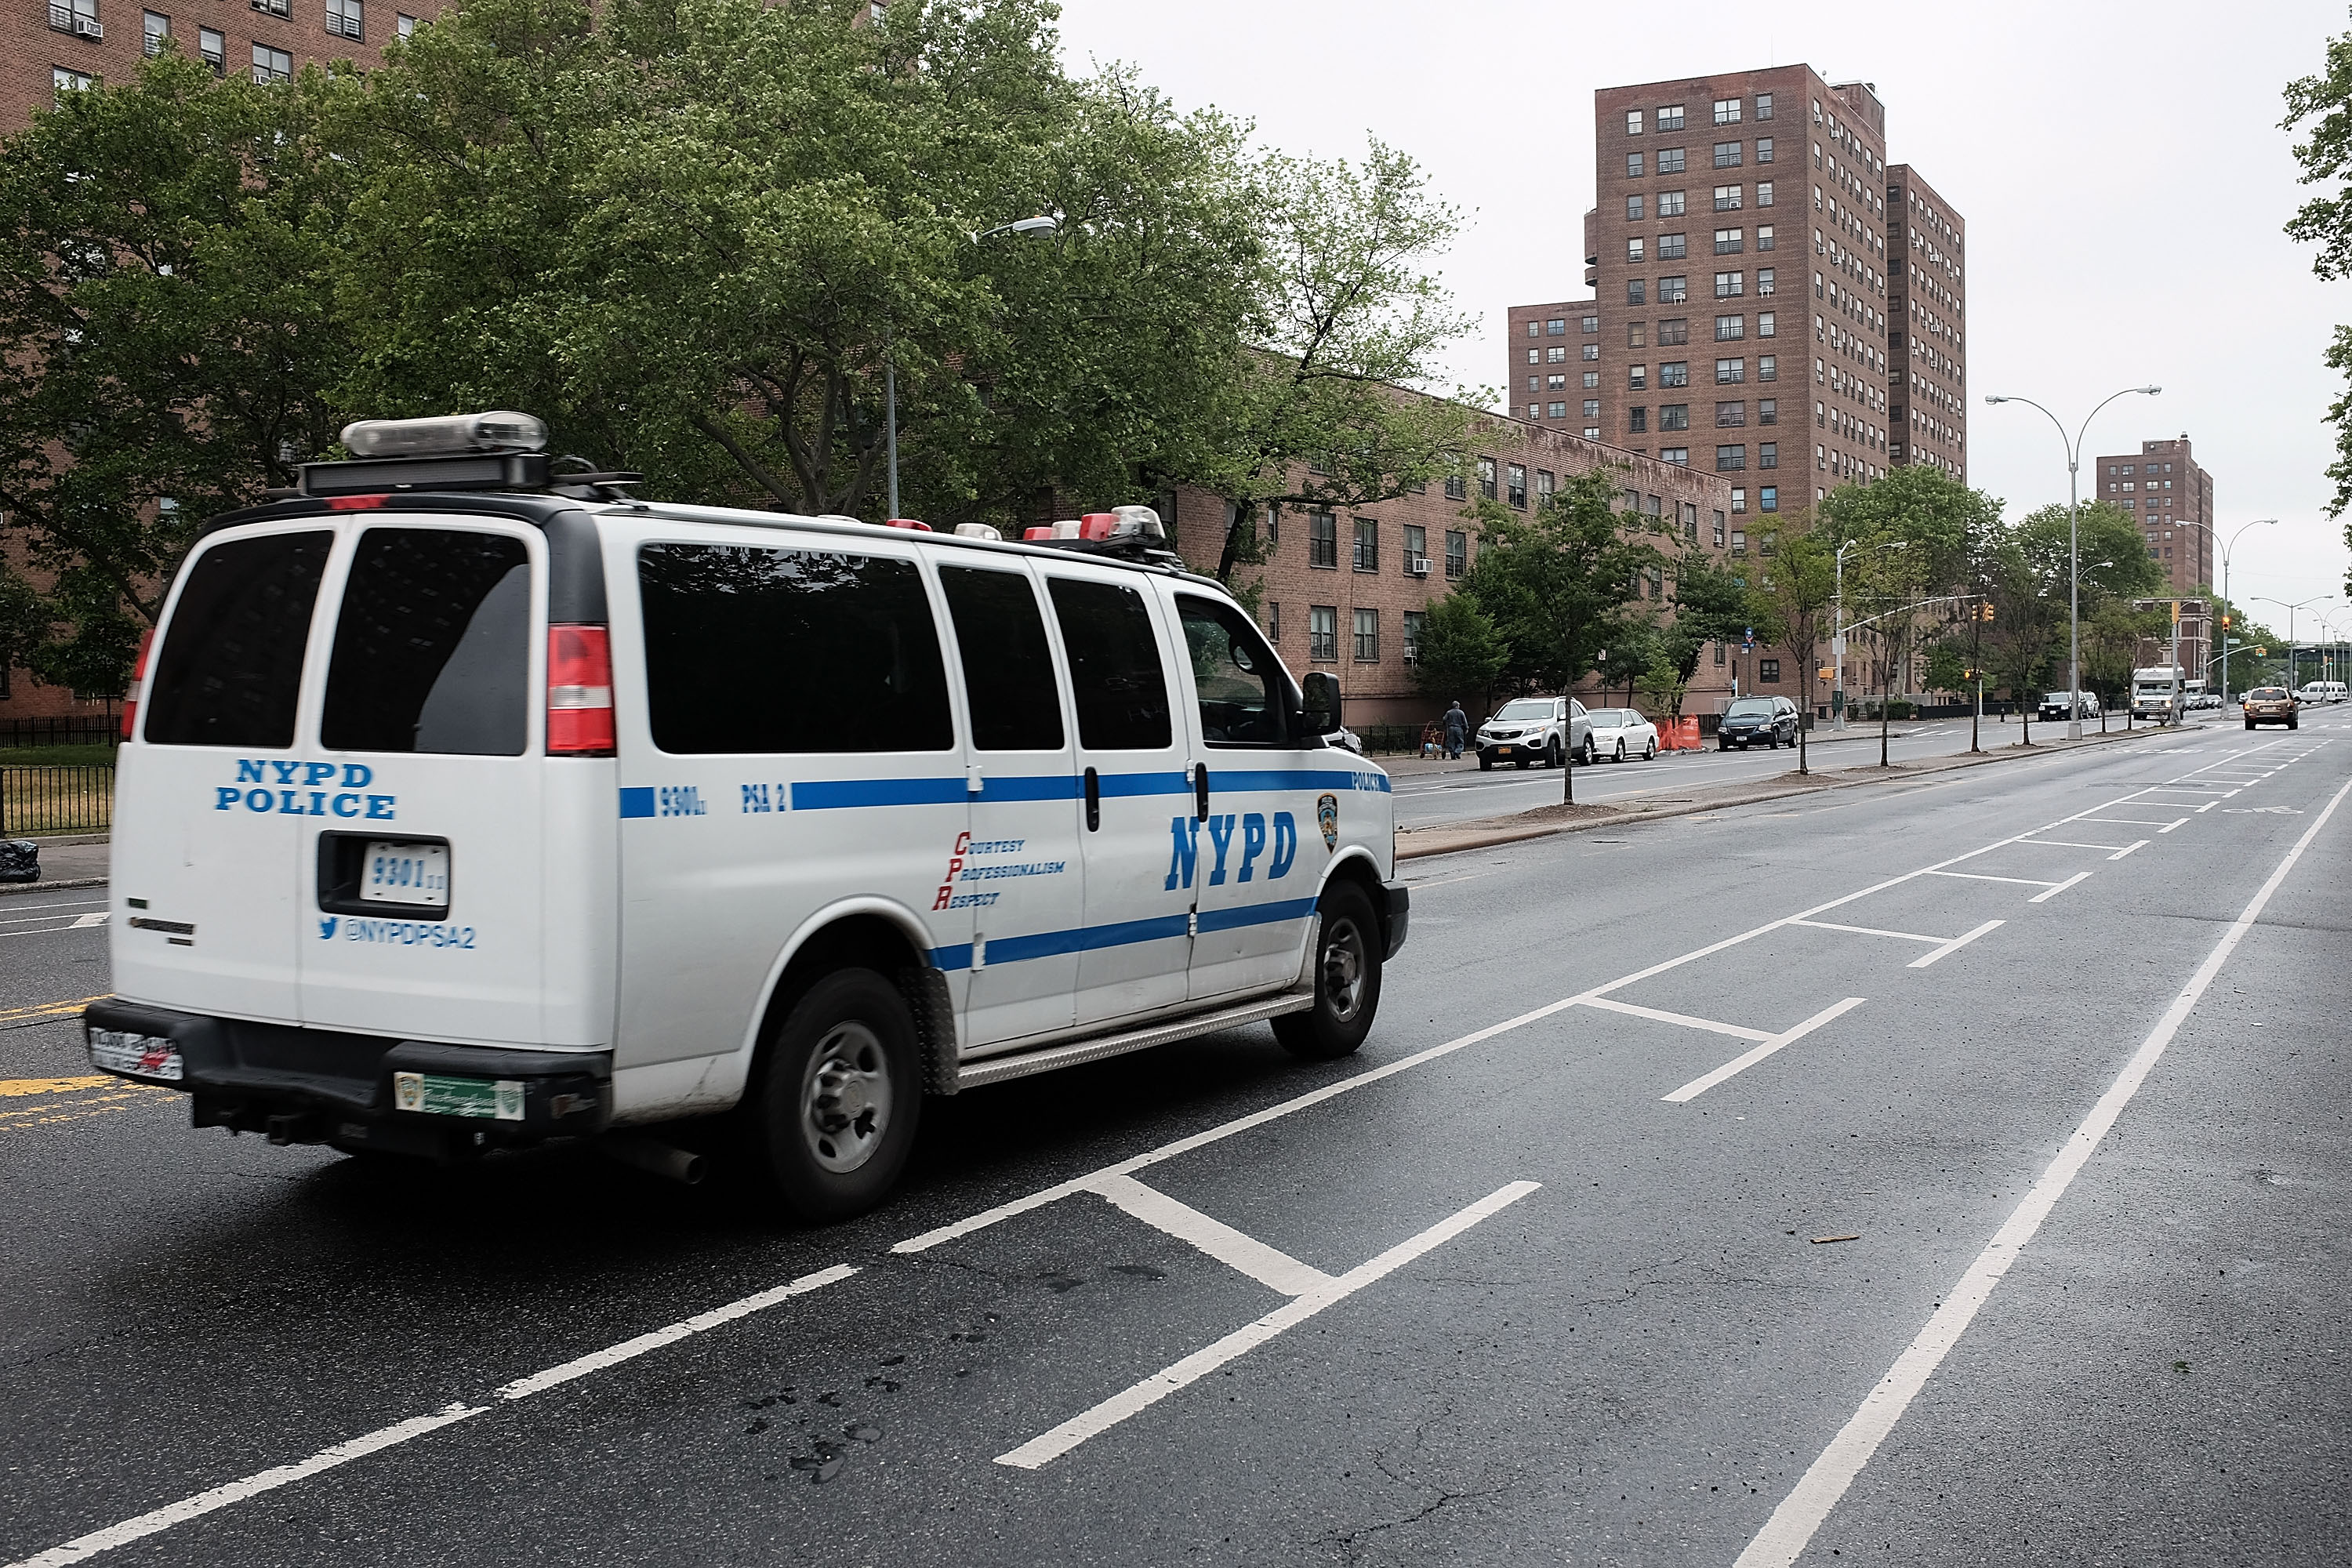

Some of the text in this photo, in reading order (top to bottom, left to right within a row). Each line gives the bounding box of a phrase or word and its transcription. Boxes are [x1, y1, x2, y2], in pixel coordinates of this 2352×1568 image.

[237, 759, 372, 788] NYPD
[215, 786, 396, 820] POLICE
[741, 784, 770, 813] PSA
[776, 783, 786, 812] 2
[954, 831, 1025, 855] COURTESY
[1164, 811, 1298, 891] NYPD
[945, 858, 1066, 883] PROFESSIONALISM
[931, 885, 1000, 911] RESPECT
[344, 919, 477, 949] @NYPDPSA2
